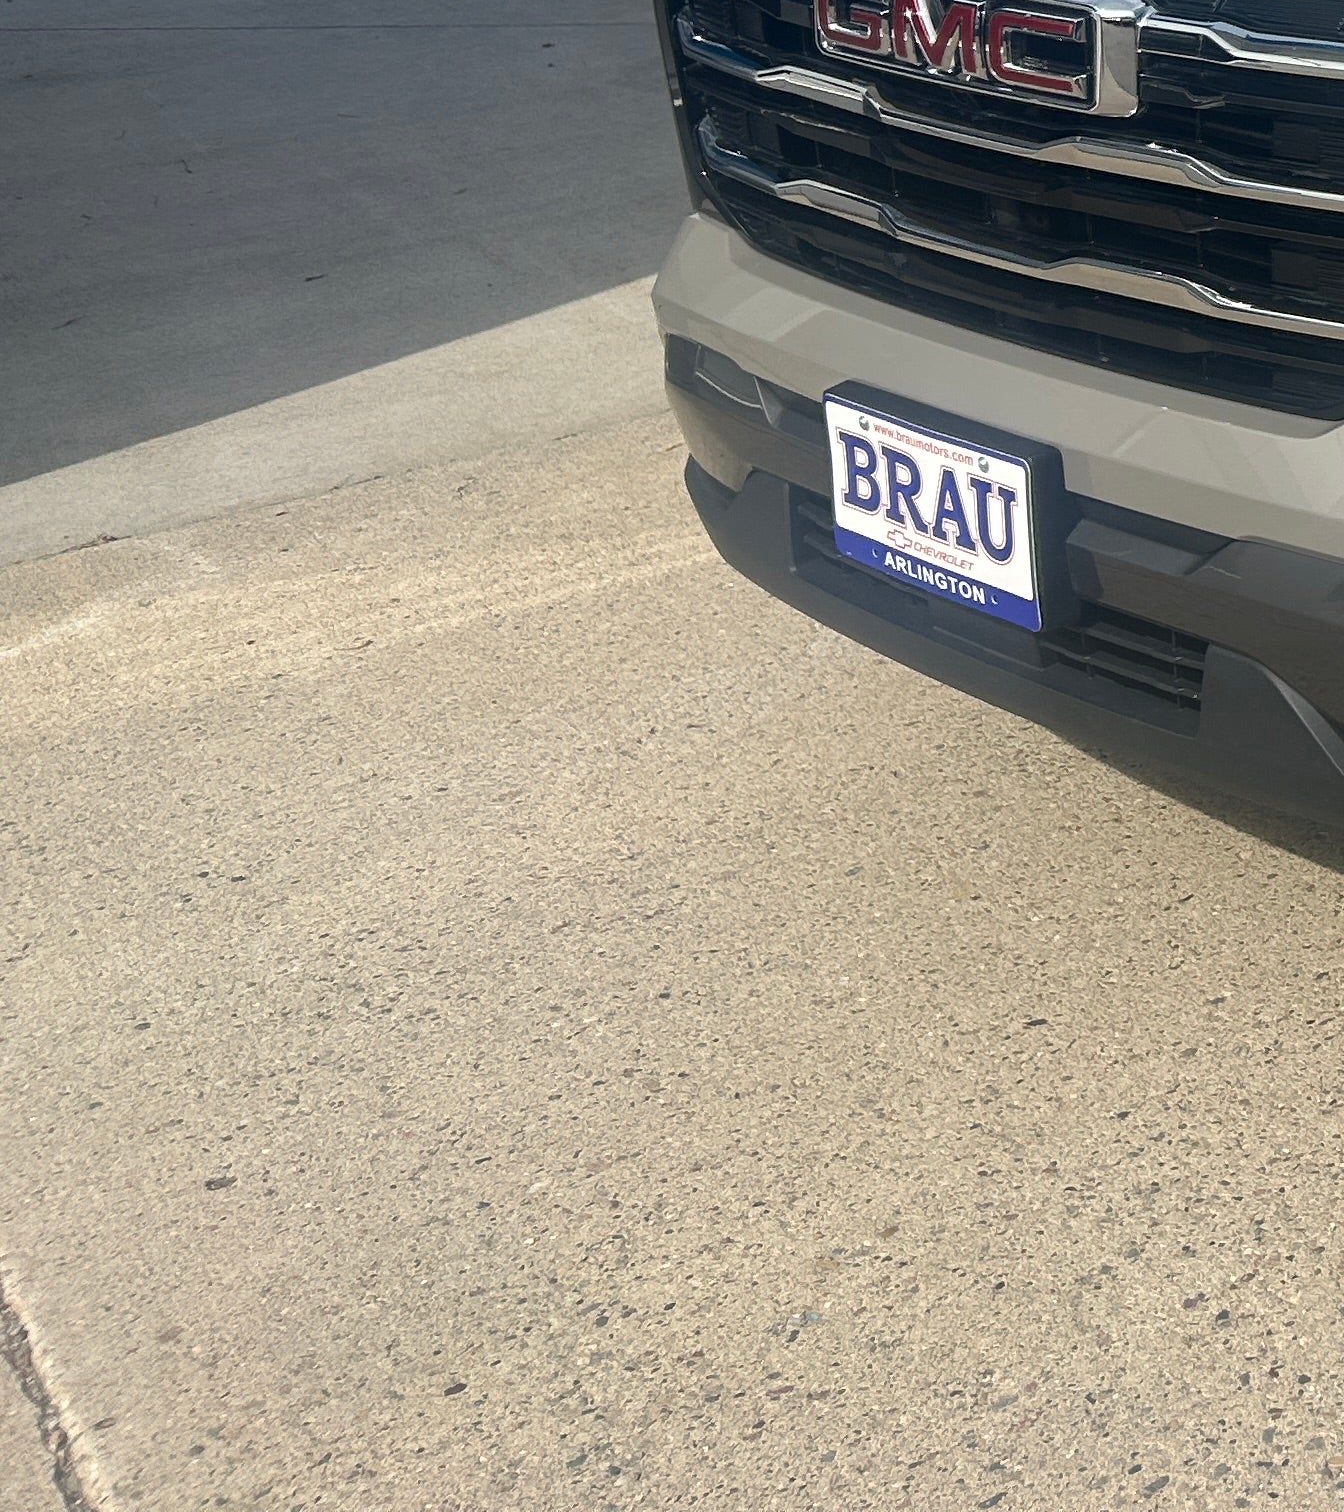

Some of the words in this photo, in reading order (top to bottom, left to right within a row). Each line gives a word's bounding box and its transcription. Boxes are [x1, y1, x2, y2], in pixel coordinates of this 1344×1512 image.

[873, 422, 974, 467] www.braumotors.com
[837, 429, 1018, 564] BRAU
[884, 551, 986, 605] ARLINGTON
[913, 542, 975, 571] CHEVROLET
